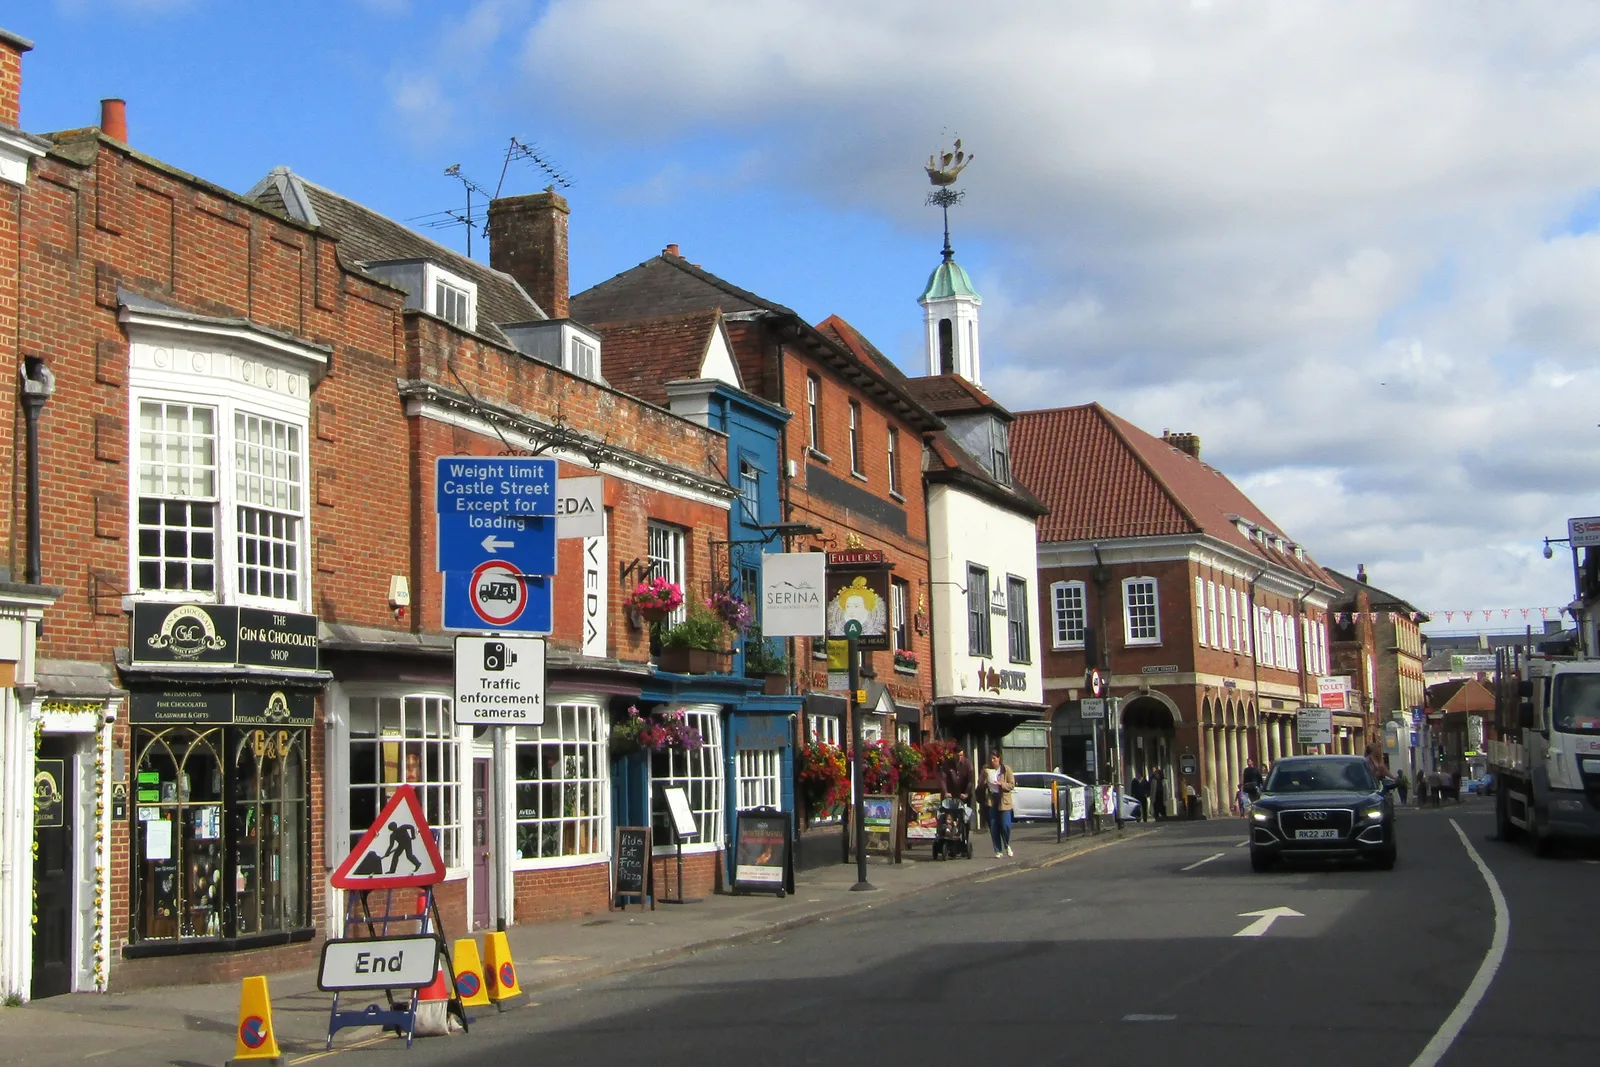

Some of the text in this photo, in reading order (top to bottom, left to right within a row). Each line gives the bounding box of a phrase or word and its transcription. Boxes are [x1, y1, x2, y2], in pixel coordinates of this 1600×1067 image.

[450, 464, 544, 480] Weight limit
[444, 481, 550, 495] Castle Street
[456, 498, 537, 515] Except for
[557, 497, 595, 514] EDA
[469, 514, 525, 531] loading
[831, 553, 878, 563] FULLER'S
[587, 536, 598, 645] VEDA
[767, 592, 819, 604] SERINA
[179, 608, 213, 632] CHOCOLATE
[272, 614, 287, 626] THE
[849, 623, 857, 632] A
[239, 626, 317, 648] GIN & CHOCOLATE
[270, 650, 289, 661] SHOP
[480, 678, 521, 690] Traffic
[1000, 669, 1027, 692] SPORTS
[460, 693, 540, 705] enforcement
[235, 715, 267, 723] ARTISAN GINS
[474, 708, 526, 719] cameras
[254, 729, 289, 759] G & C
[622, 833, 643, 846] Kids
[1299, 830, 1334, 838] RK22 JXF
[622, 847, 637, 857] Eat
[619, 857, 642, 868] Free
[619, 867, 642, 882] Pizza
[355, 950, 404, 973] End
